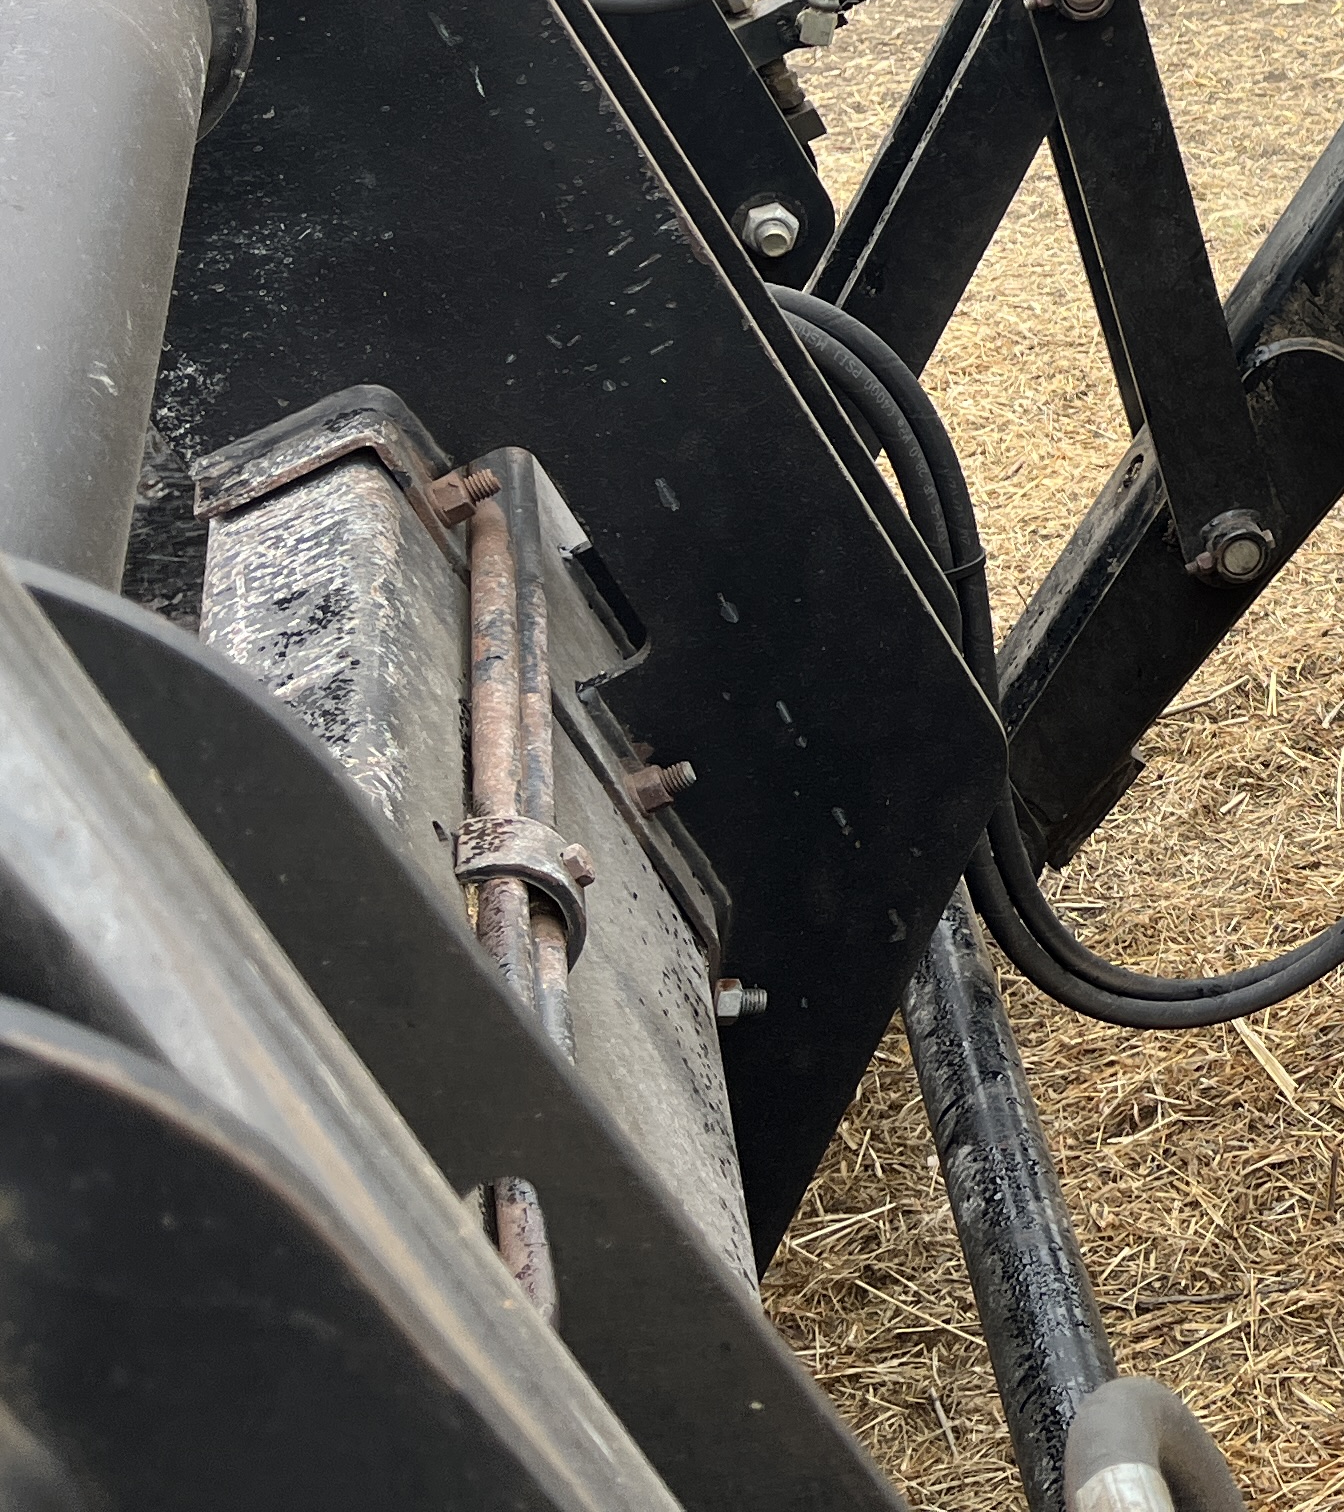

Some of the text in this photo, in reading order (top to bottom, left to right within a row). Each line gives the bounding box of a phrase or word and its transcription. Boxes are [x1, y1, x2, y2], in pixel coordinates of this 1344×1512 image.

[832, 349, 864, 380] PSI)
[862, 377, 899, 419] (4000
[908, 445, 929, 478] 28.0
